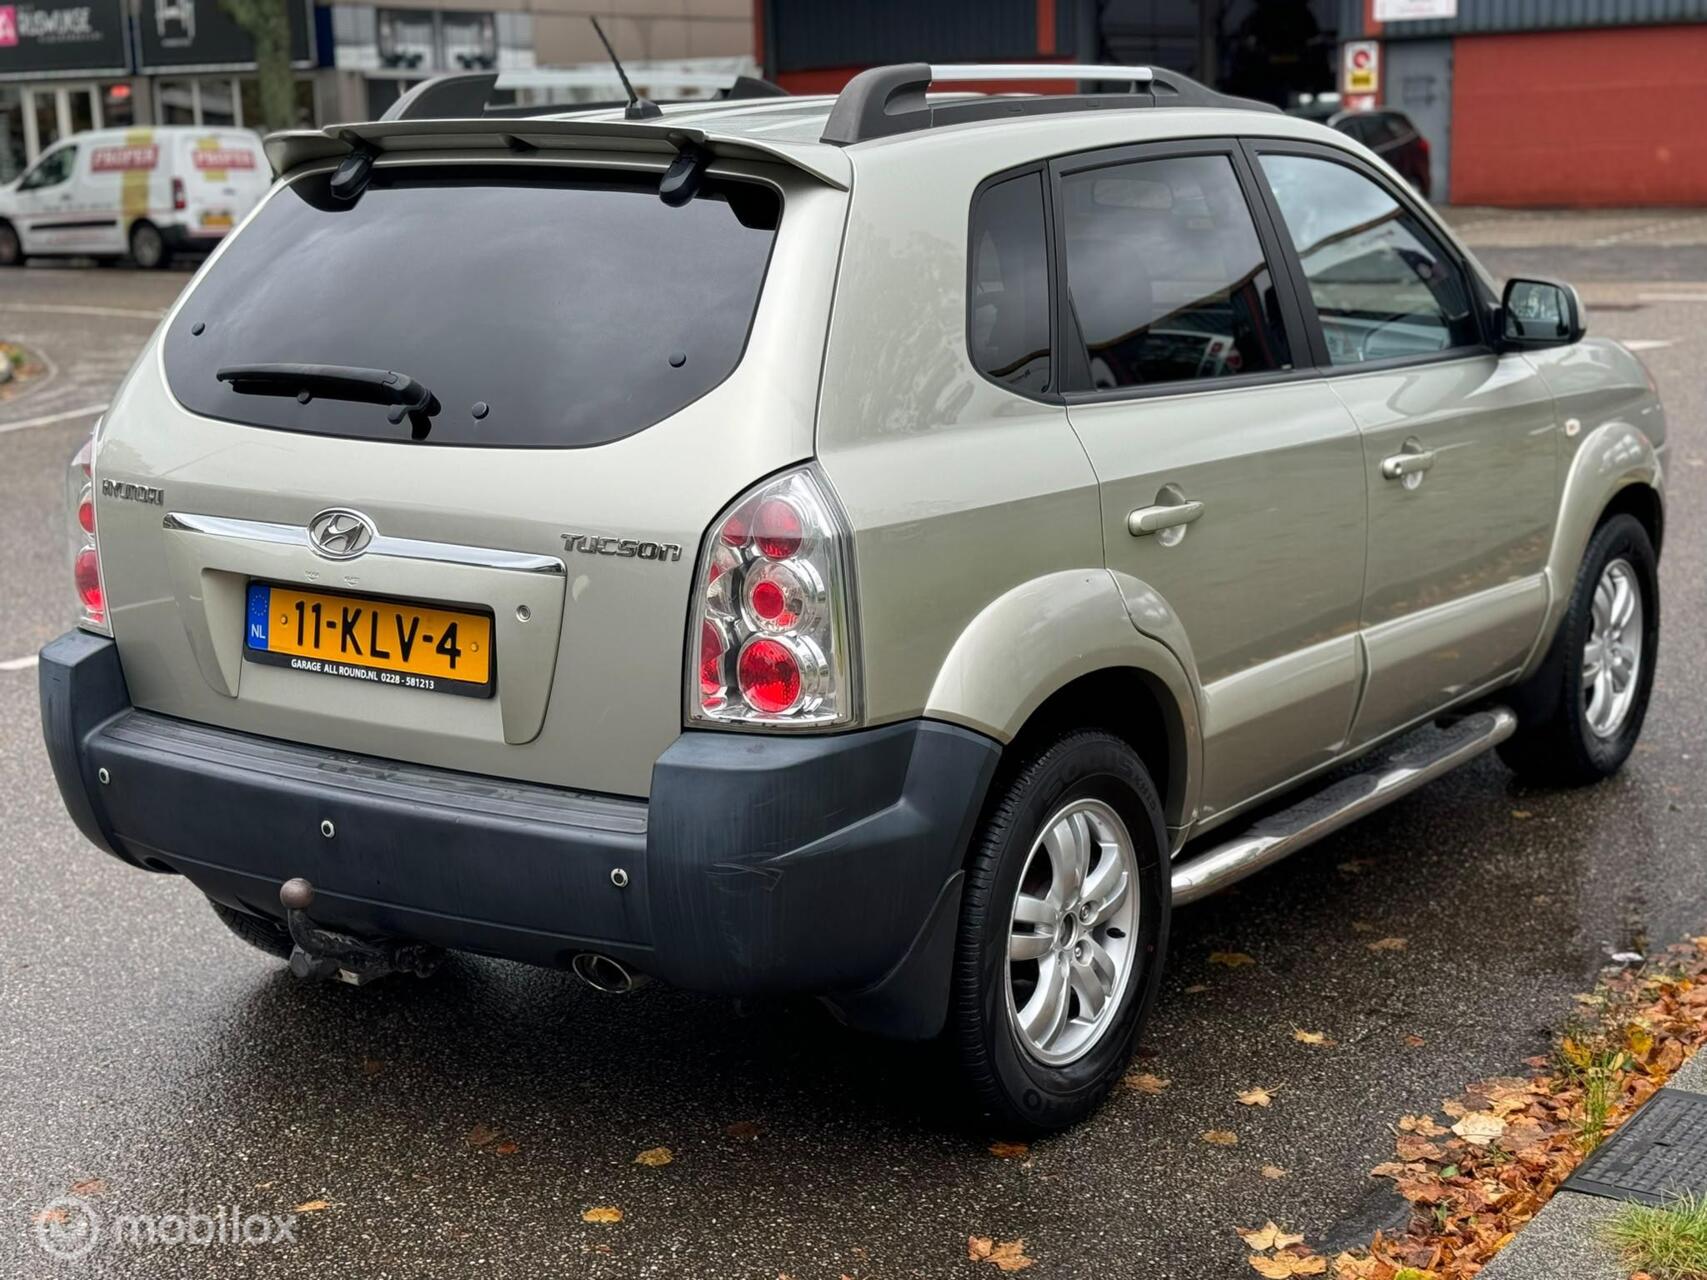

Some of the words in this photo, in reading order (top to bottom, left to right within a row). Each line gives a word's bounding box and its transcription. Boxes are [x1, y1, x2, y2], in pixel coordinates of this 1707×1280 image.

[102, 478, 164, 506] HYUNDAI
[560, 532, 683, 562] TUCSON
[251, 623, 266, 640] NL
[295, 600, 462, 670] 11-KLV-4
[291, 658, 322, 672] GARAGE
[323, 663, 338, 675] ALL
[338, 665, 379, 681] ROUND.NL
[380, 672, 400, 685] 0228
[405, 676, 435, 690] 581213
